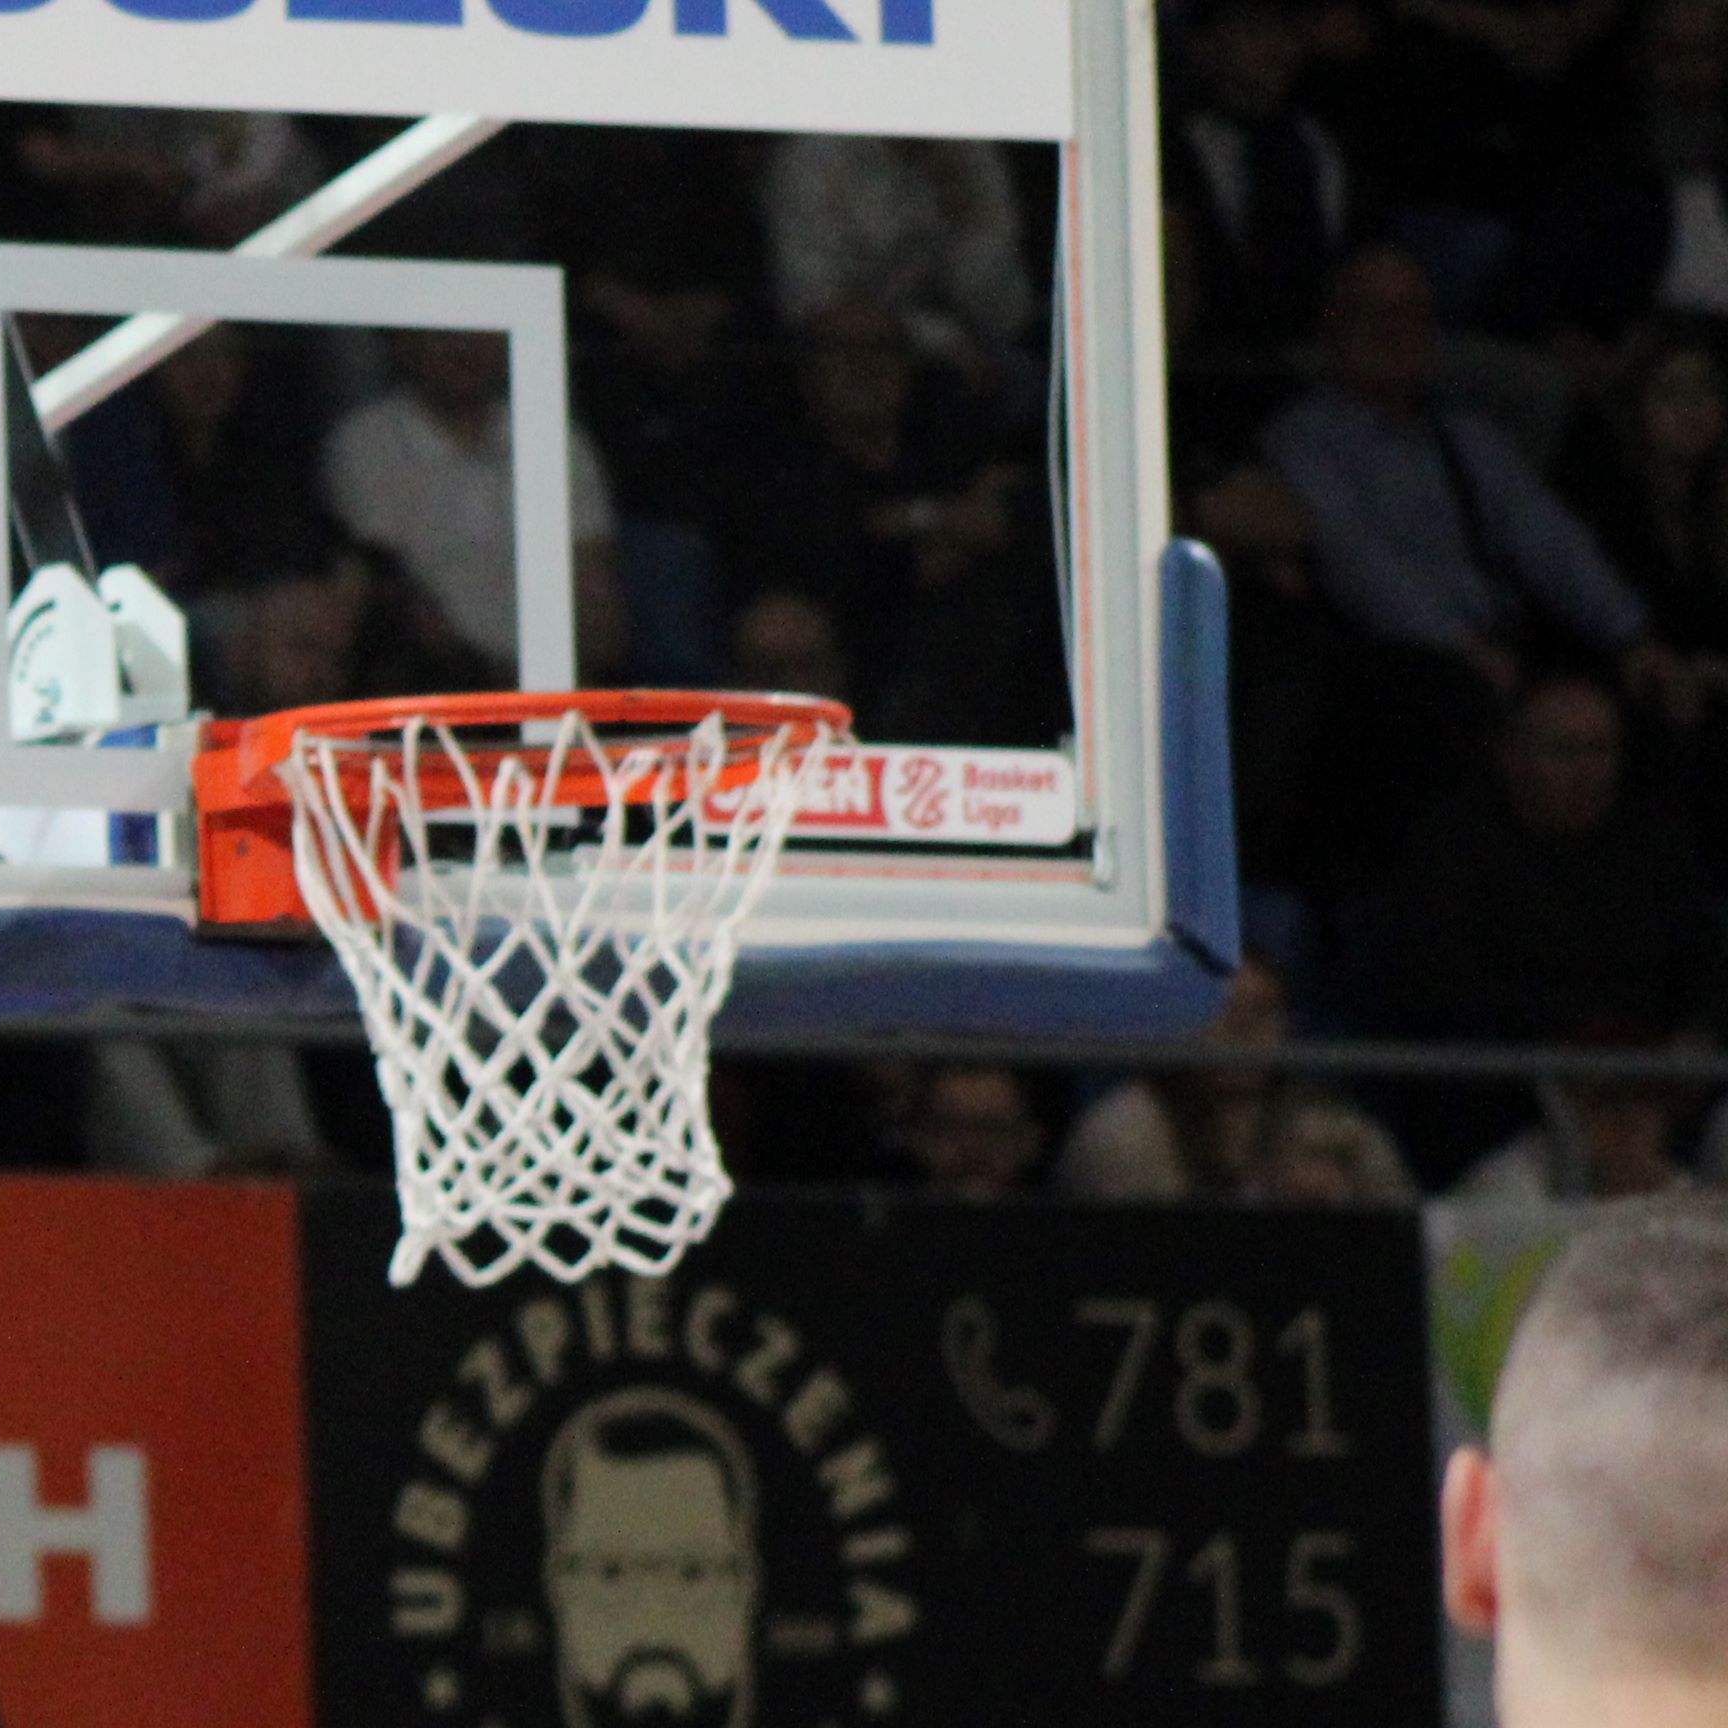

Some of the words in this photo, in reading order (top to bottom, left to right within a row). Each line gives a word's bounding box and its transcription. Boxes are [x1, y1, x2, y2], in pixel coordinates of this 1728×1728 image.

[963, 762, 1056, 794] Basket
[963, 801, 1022, 830] Liga
[1075, 1300, 1352, 1458] 781
[1084, 1527, 1364, 1688] 715
